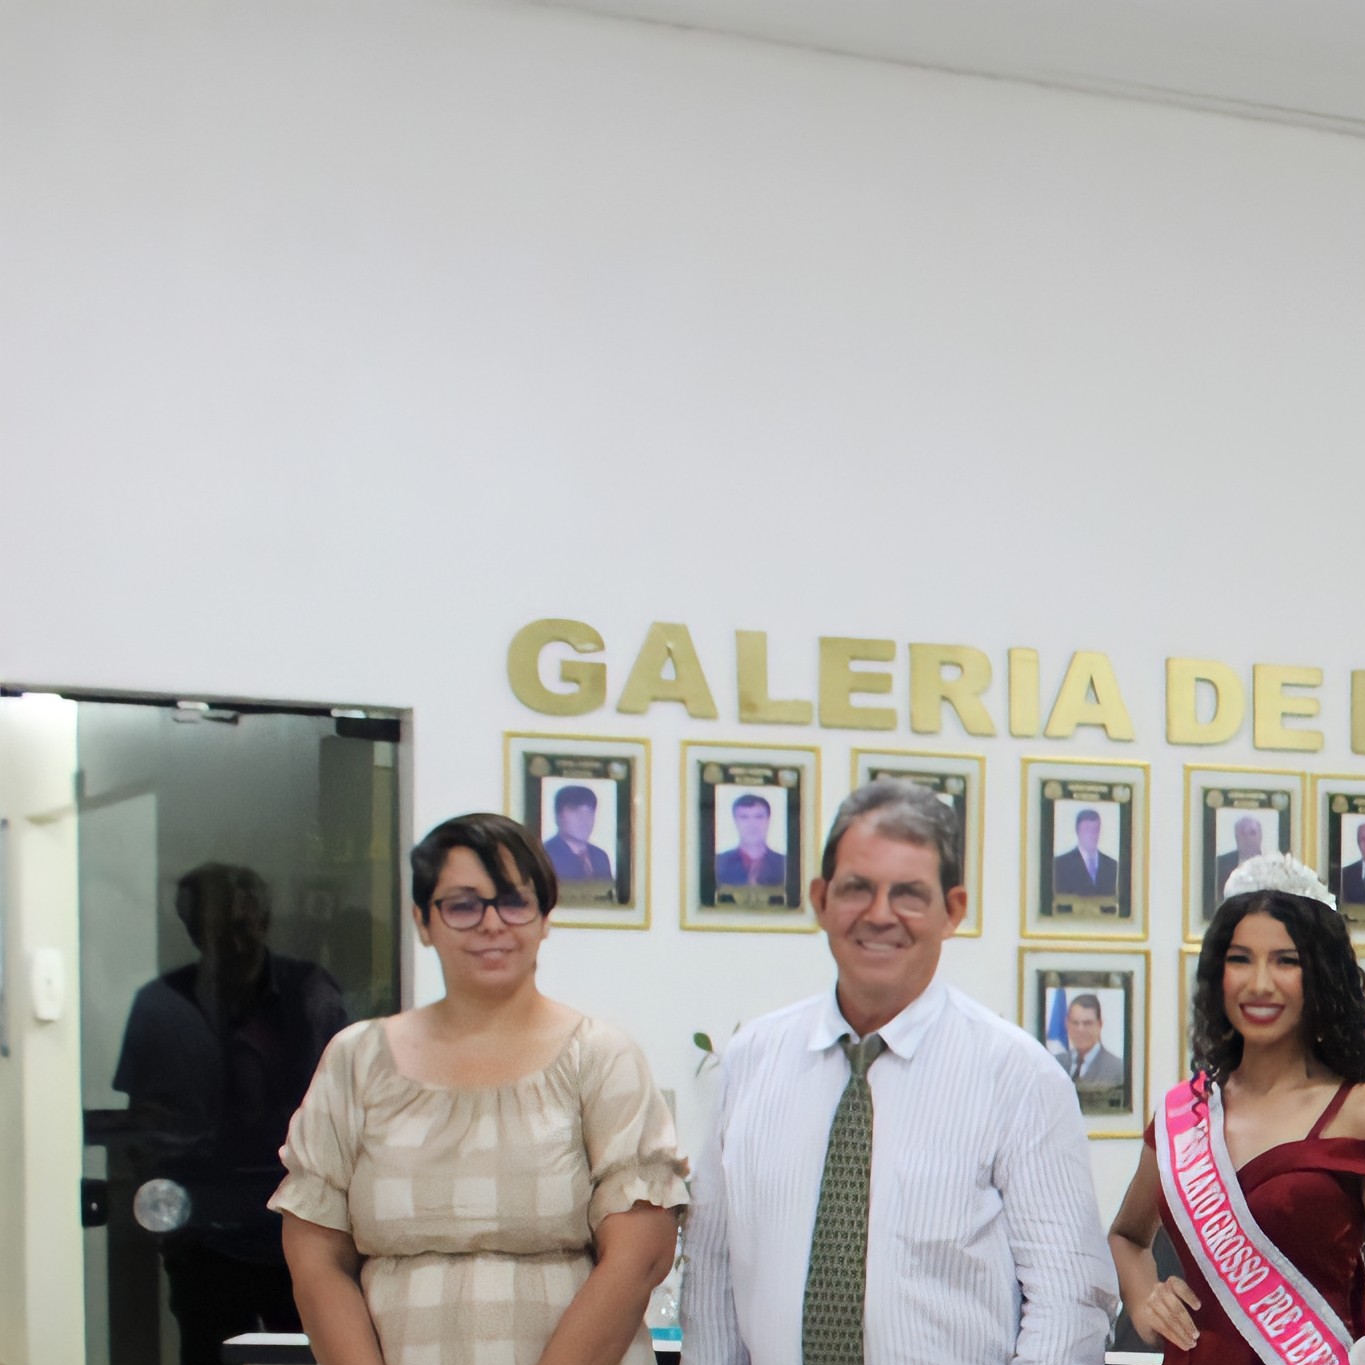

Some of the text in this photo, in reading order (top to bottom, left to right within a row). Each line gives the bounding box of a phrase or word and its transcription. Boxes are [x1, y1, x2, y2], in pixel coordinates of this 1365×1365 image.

[506, 618, 1136, 741] GALERIA
[1165, 656, 1324, 751] DE
[1201, 1209, 1270, 1295] GROSSO
[1250, 1284, 1302, 1338] PRE
